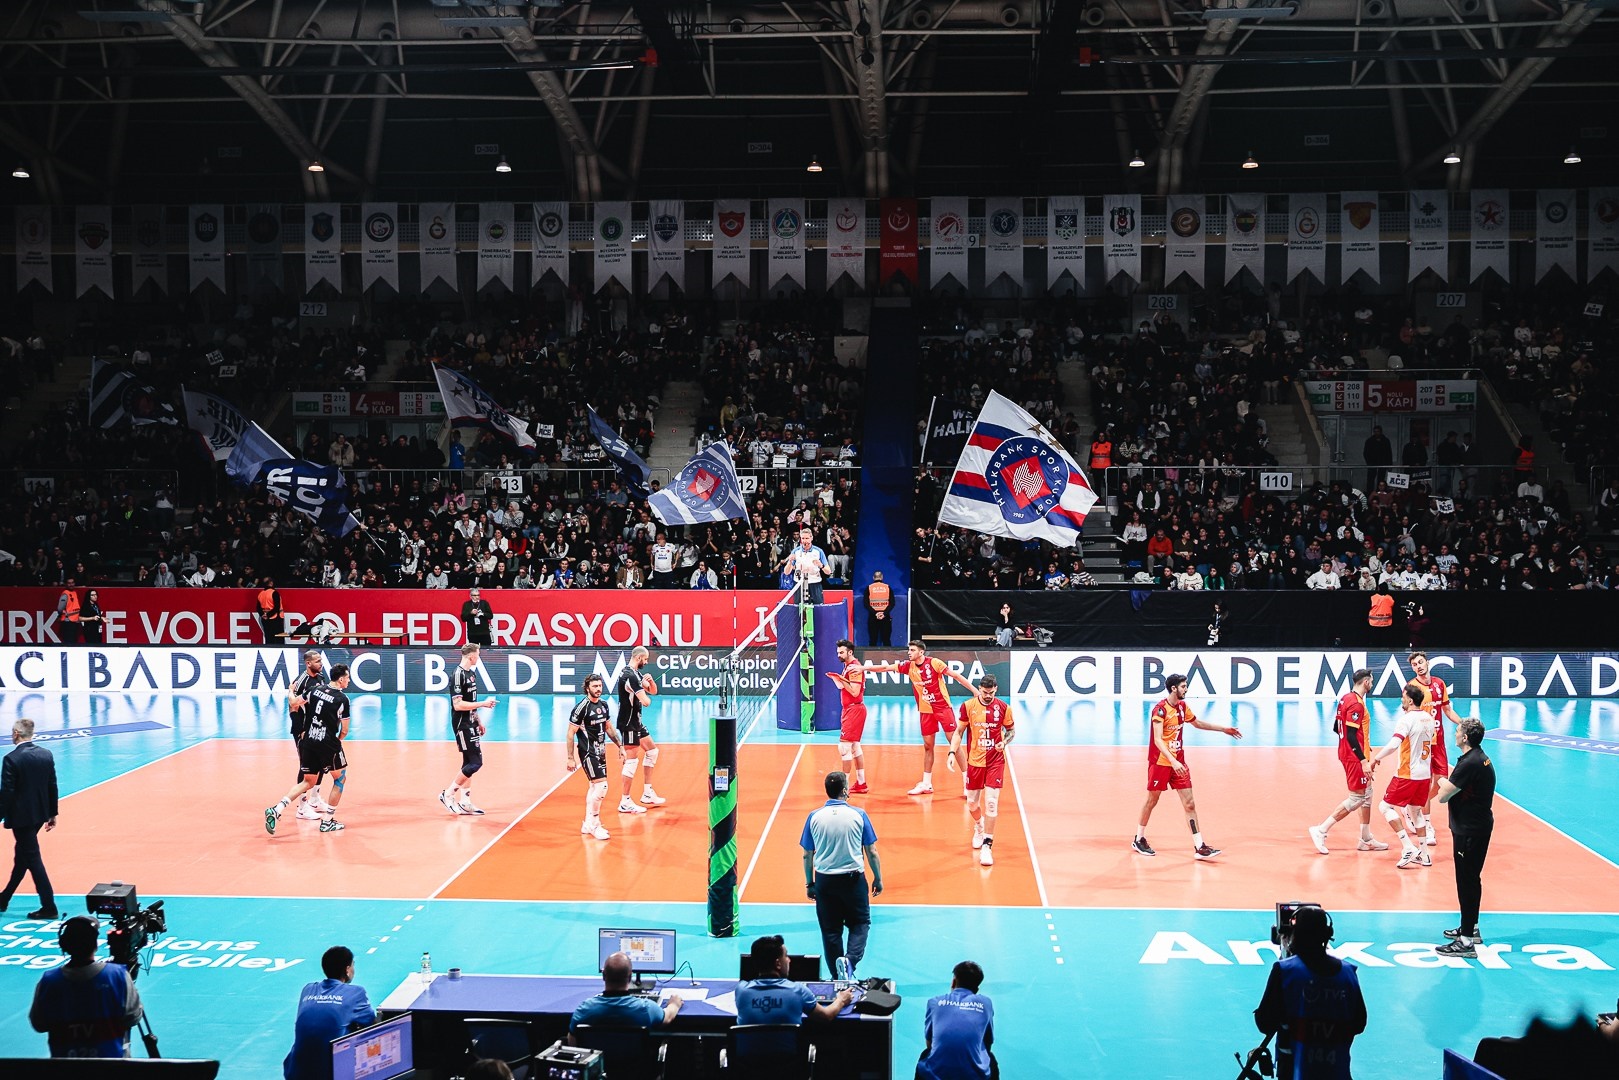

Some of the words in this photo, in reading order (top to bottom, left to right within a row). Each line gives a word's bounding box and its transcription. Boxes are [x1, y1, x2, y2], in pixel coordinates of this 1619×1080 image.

[1151, 296, 1174, 308] 208
[1439, 294, 1463, 306] 207
[303, 304, 324, 315] 212
[1347, 392, 1360, 400] 110
[1367, 383, 1382, 408] 5
[1419, 386, 1433, 394] 207
[355, 393, 369, 414] 4
[1348, 401, 1360, 409] 111
[1386, 397, 1414, 408] KAPI
[372, 405, 394, 415] KAPI
[991, 444, 1023, 507] HALKBANK
[1031, 445, 1060, 473] SPOR
[1263, 475, 1288, 488] 110
[503, 479, 519, 491] 13
[739, 479, 754, 491] 12
[1389, 478, 1406, 487] ACE
[0, 611, 127, 644] RKE
[382, 612, 702, 647] FEDRASYONU
[656, 654, 693, 669] CEV
[695, 654, 777, 673] Chmpion
[0, 650, 291, 691] CIBADEM
[862, 659, 986, 684] ANRA
[1017, 653, 1364, 695] ACIBADEM
[662, 674, 724, 692] League
[728, 674, 778, 692] Volley
[922, 687, 930, 695] 6
[314, 699, 324, 714] 6
[979, 729, 991, 740] 21
[978, 739, 995, 749] HDI
[1422, 744, 1432, 765] 5
[151, 953, 305, 972] Volley
[947, 1000, 984, 1009] HALKBANK
